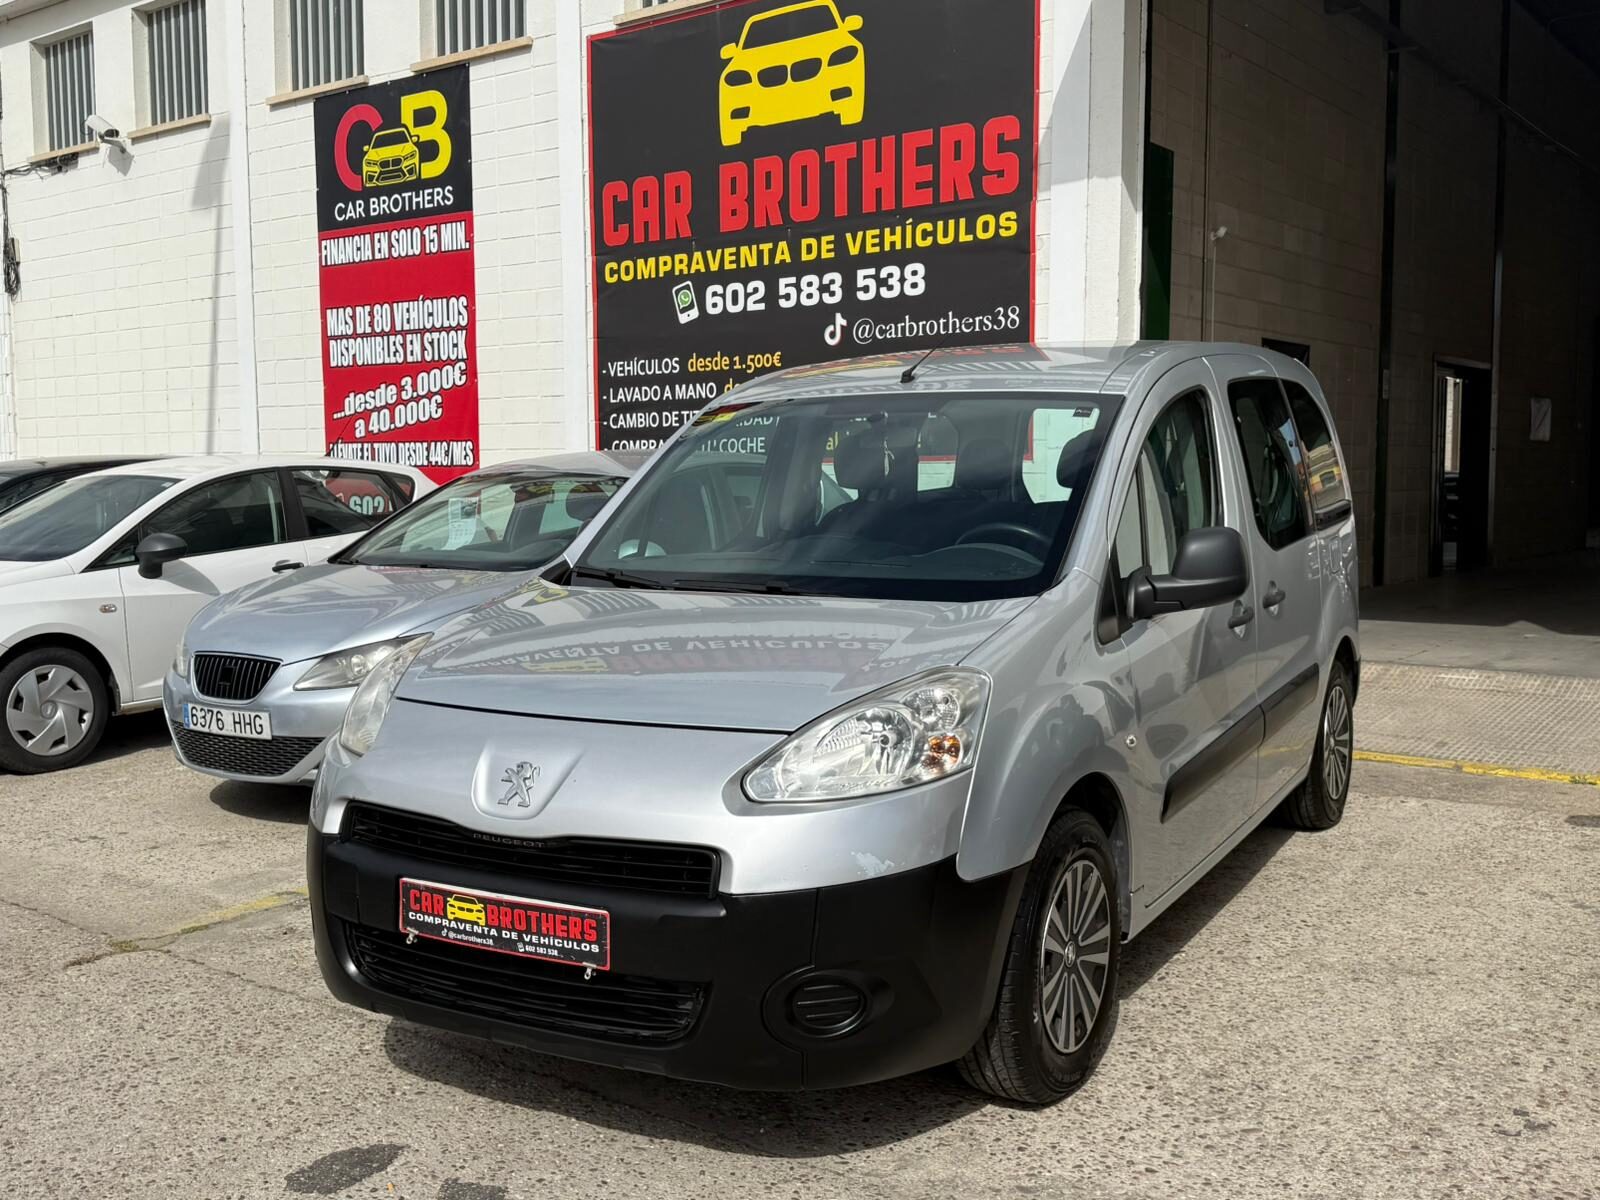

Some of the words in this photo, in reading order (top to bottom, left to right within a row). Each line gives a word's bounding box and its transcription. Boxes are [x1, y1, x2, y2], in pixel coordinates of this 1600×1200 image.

[602, 169, 693, 247] CAR
[719, 114, 1021, 234] BROTHERS
[334, 200, 365, 222] CAR
[369, 185, 454, 217] BROTHERS
[321, 235, 373, 267] FINANCIA
[374, 231, 389, 260] EN
[390, 227, 421, 259] SOLO
[422, 224, 438, 255] 15
[440, 221, 470, 252] MIN.
[604, 241, 792, 284] COMPRAVENTA
[801, 234, 836, 263] DE
[846, 211, 1019, 258] VEHÍCULOS
[705, 279, 766, 316] 602
[778, 272, 843, 309] 583
[856, 262, 927, 302] 538
[326, 307, 354, 337] MAS
[355, 305, 372, 334] DE
[373, 303, 391, 333] 80
[393, 295, 468, 332] VEHÍCULOS
[852, 305, 1021, 345] @carbrothers38
[329, 334, 404, 368] DISPONIBLES
[405, 332, 422, 363] EN
[424, 330, 468, 362] STOCK
[687, 351, 730, 372] desde
[733, 351, 782, 374] 1.500€
[400, 362, 467, 400] 3.000€
[663, 384, 673, 401] A
[675, 382, 717, 400] MANO
[354, 418, 365, 438] a
[368, 394, 443, 434] 40.000€
[662, 411, 680, 427] DE
[398, 441, 428, 466] DESDE
[190, 706, 225, 732] 6376
[232, 711, 264, 735] HHG
[473, 833, 545, 848] PEUGEOT
[408, 912, 498, 937] COMPRAVENTA
[501, 930, 519, 940] DE
[522, 934, 600, 953] VEHÍCULOS
[409, 889, 444, 916] CAR
[486, 904, 597, 942] BROTHERS
